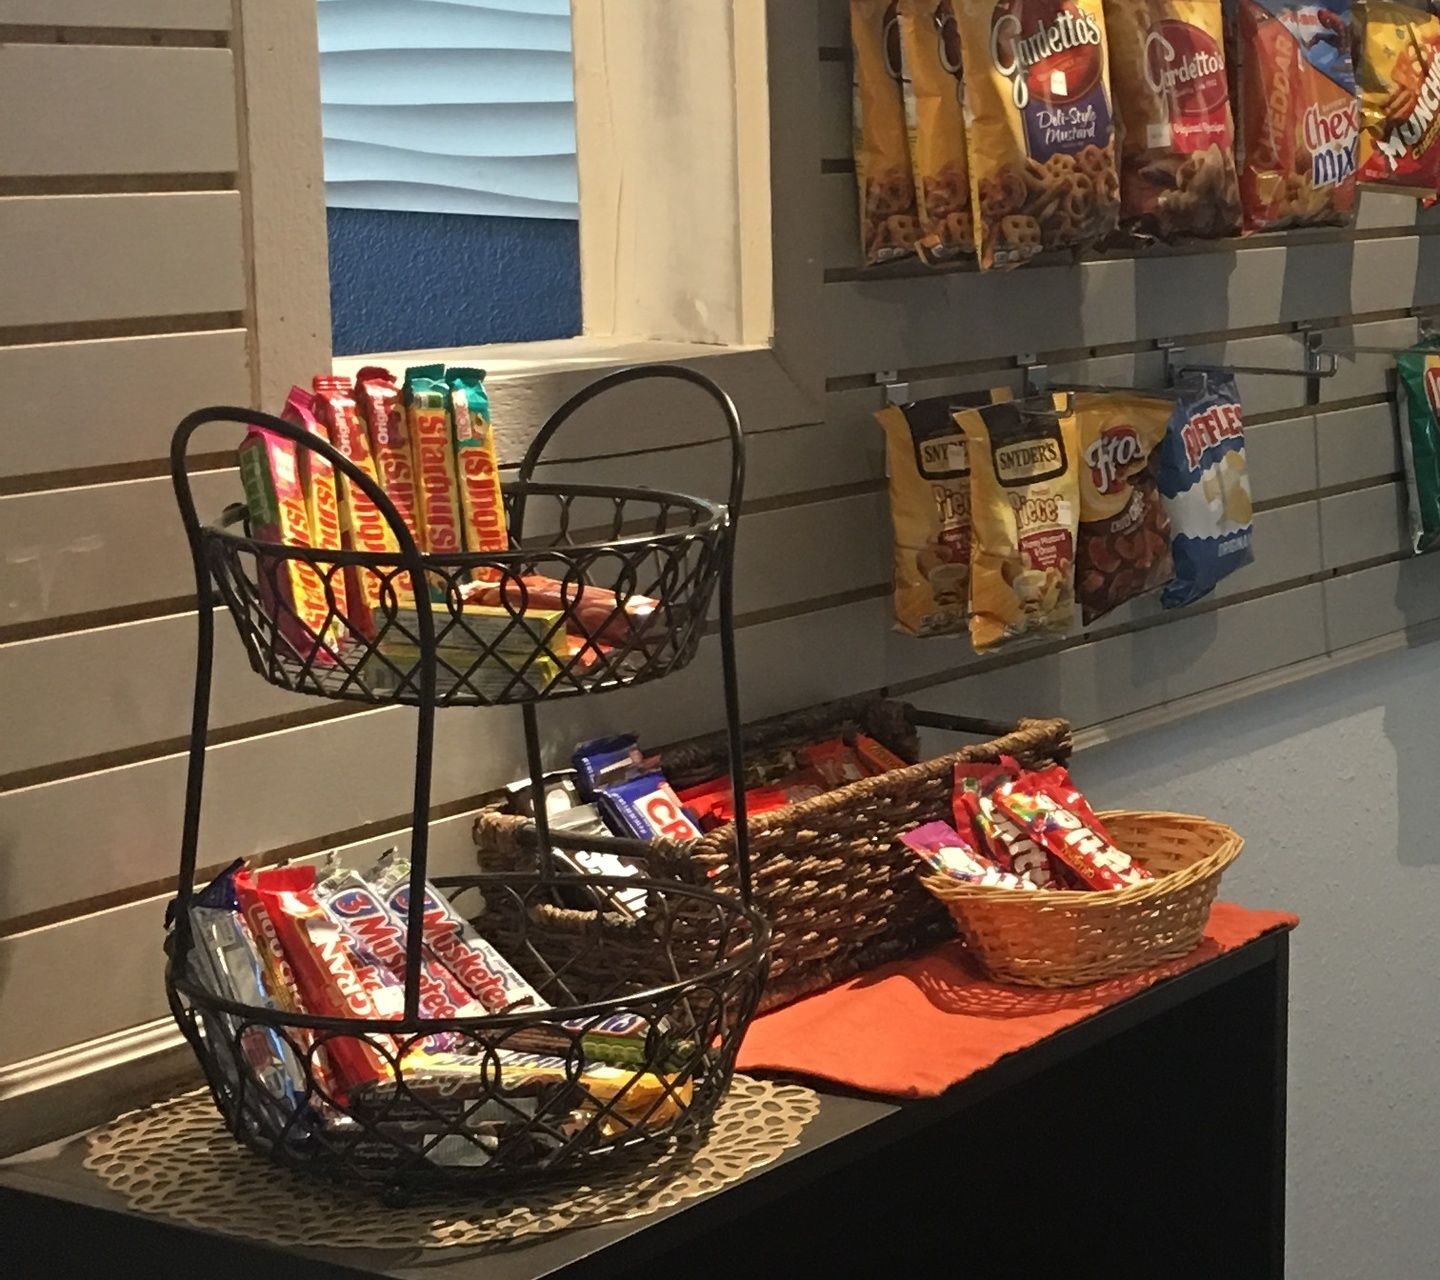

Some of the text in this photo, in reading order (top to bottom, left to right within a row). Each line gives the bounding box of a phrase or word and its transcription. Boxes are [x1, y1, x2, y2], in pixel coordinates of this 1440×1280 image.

[991, 9, 1101, 109] Gardetto's
[1045, 122, 1096, 145] Mustard
[1304, 104, 1359, 154] Chex
[999, 442, 1057, 471] SNYDER'S
[335, 894, 372, 914] 3
[313, 933, 373, 1017] GRAN
